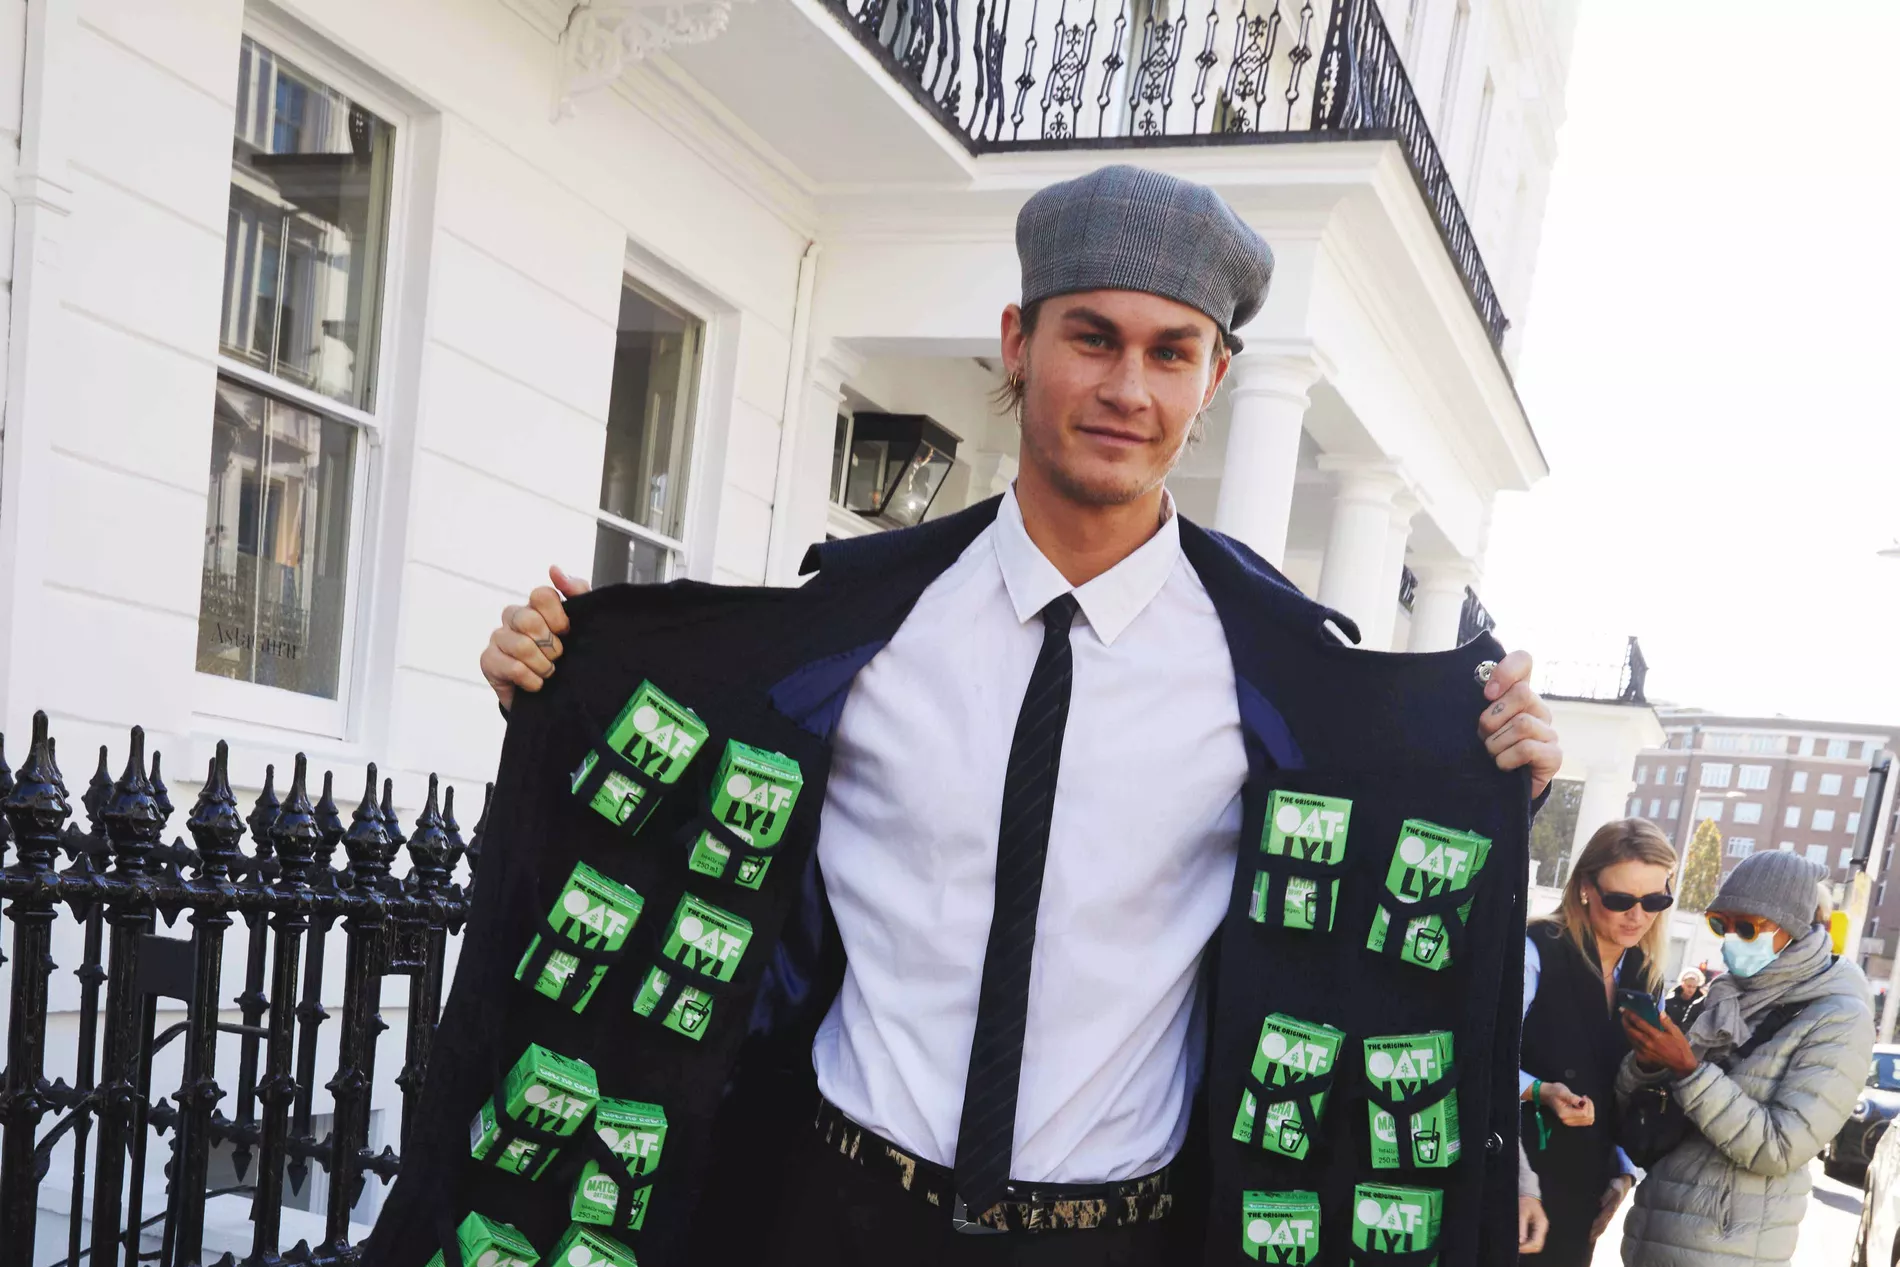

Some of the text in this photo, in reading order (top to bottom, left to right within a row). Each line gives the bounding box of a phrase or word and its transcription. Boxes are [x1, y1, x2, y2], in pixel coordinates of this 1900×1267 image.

[724, 800, 776, 835] LY!
[586, 1179, 620, 1195] MATCH
[578, 1211, 591, 1219] 250
